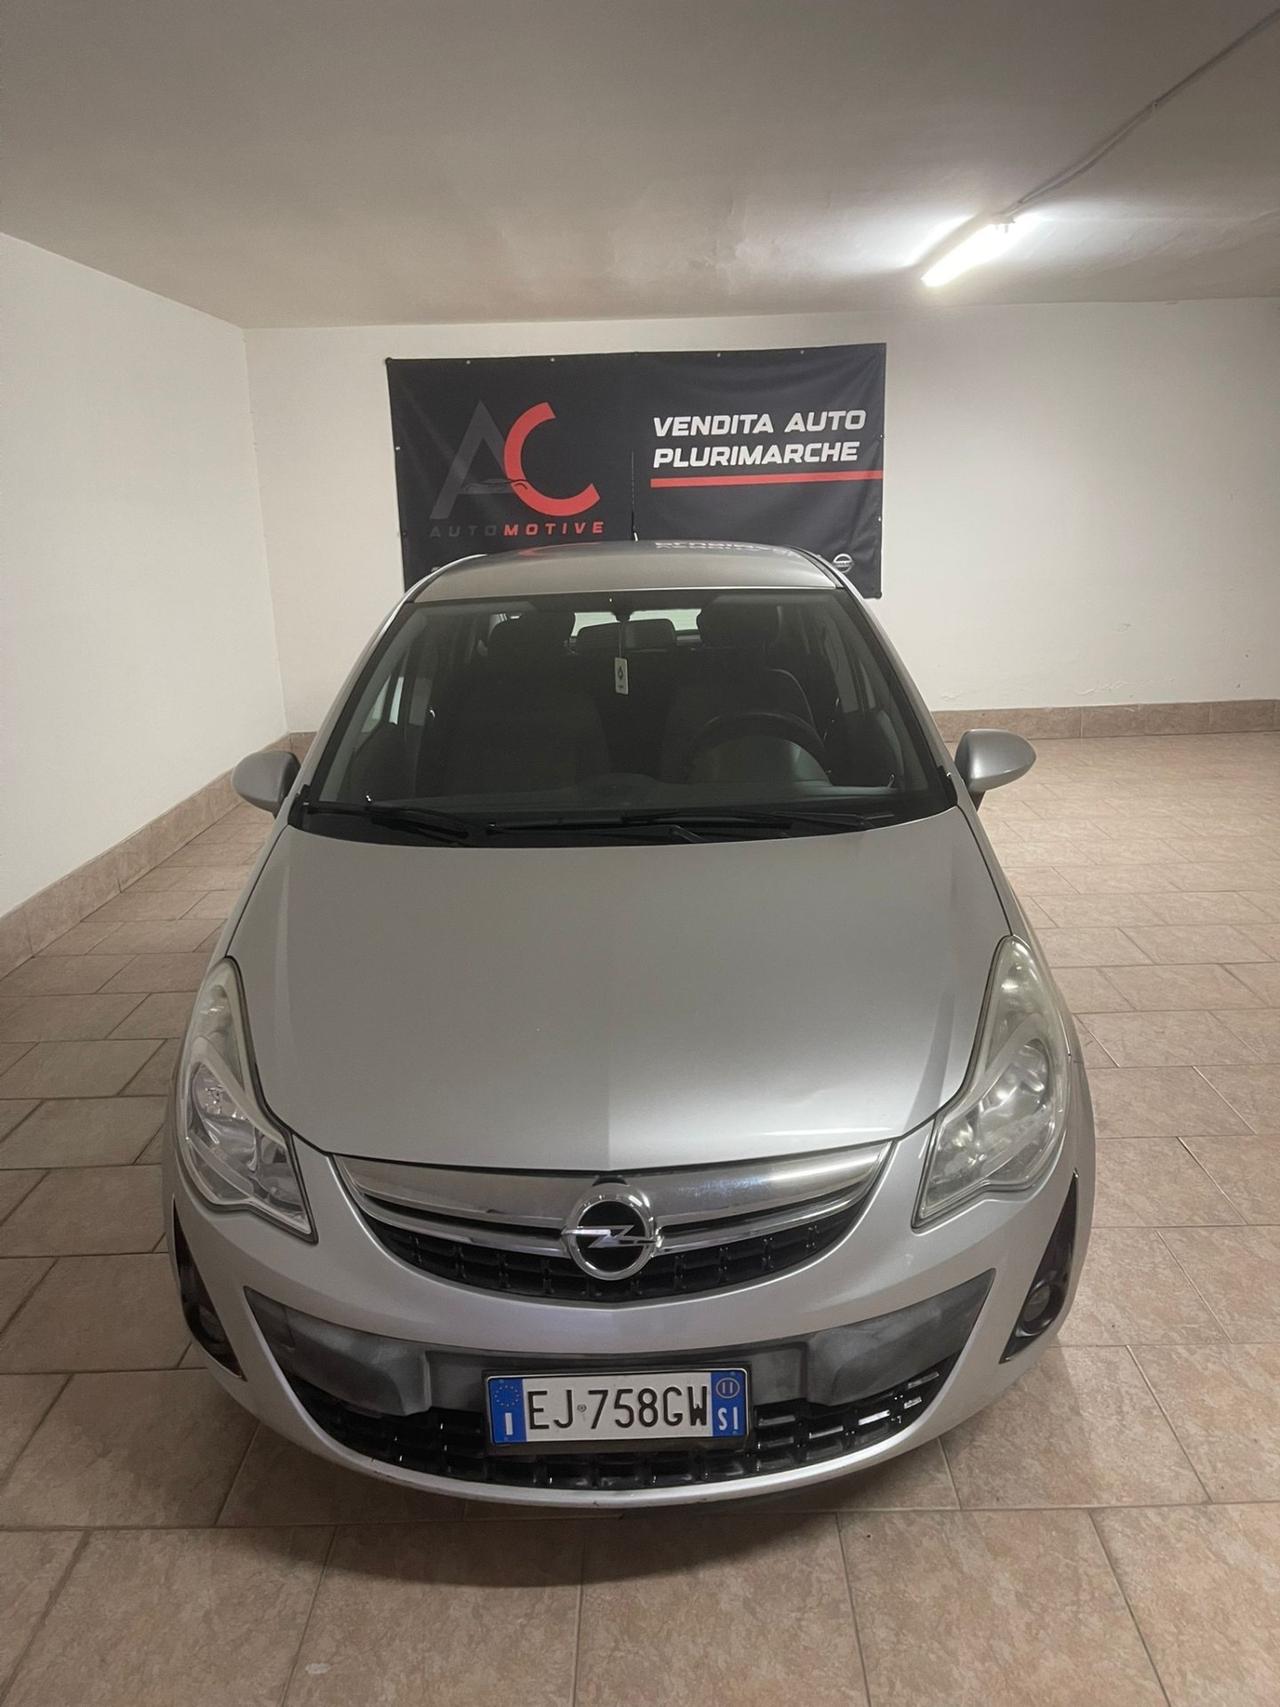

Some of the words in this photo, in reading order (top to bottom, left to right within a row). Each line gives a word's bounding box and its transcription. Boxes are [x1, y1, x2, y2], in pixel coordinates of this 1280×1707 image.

[653, 413, 774, 437] VENDITA
[785, 410, 866, 432] AUTO
[430, 400, 600, 519] AC
[653, 441, 860, 468] PLURIMARCHE
[429, 521, 604, 538] AUTOMOTIVE
[717, 1406, 739, 1431] SI
